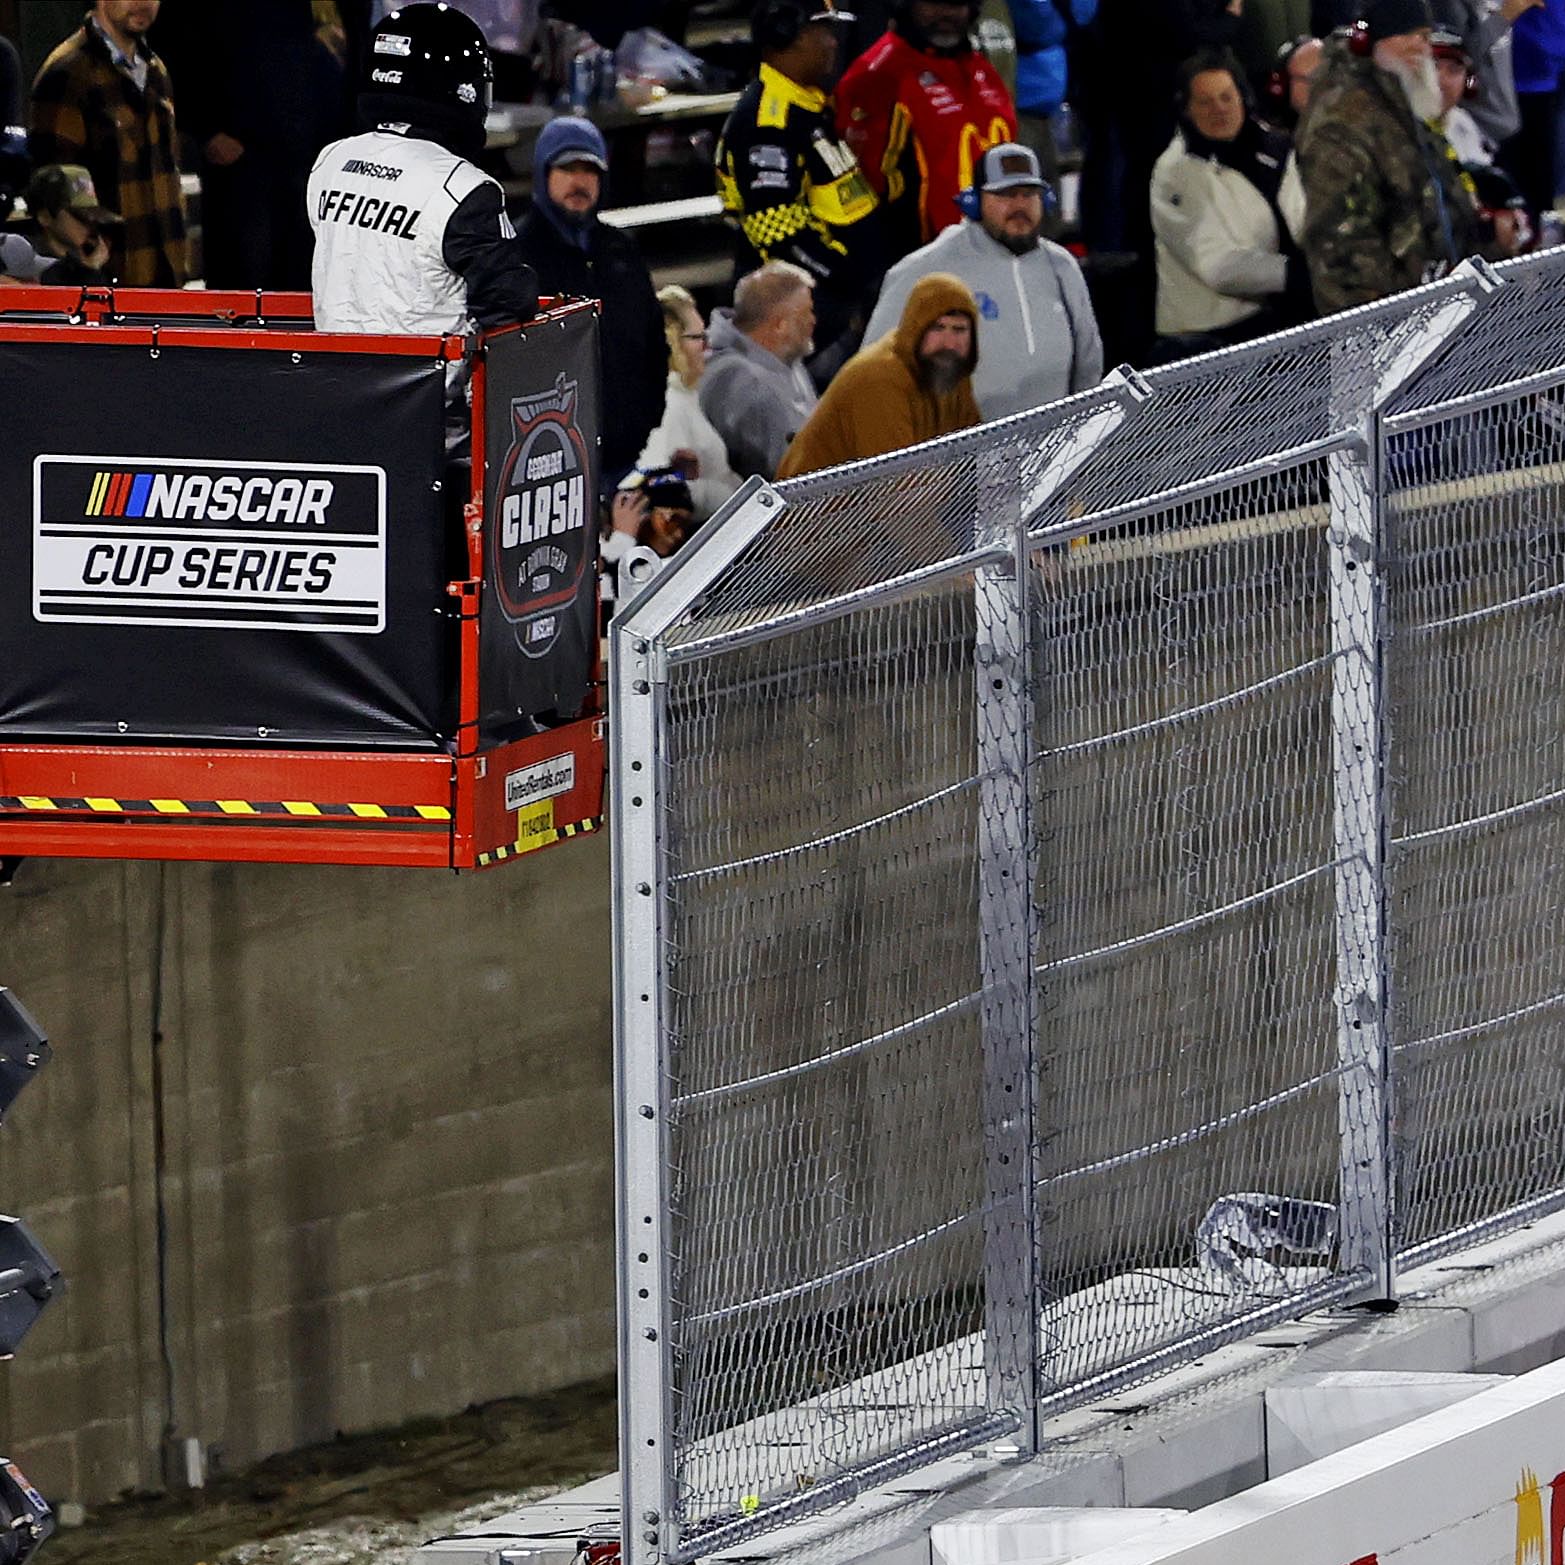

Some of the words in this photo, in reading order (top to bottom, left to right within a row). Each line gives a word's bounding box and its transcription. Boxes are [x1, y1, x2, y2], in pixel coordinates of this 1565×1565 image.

[356, 160, 403, 182] NASCAR
[145, 474, 334, 524] NASCAR
[502, 474, 584, 549] CLASH
[82, 544, 174, 587] CUP
[178, 548, 337, 593] SERIES
